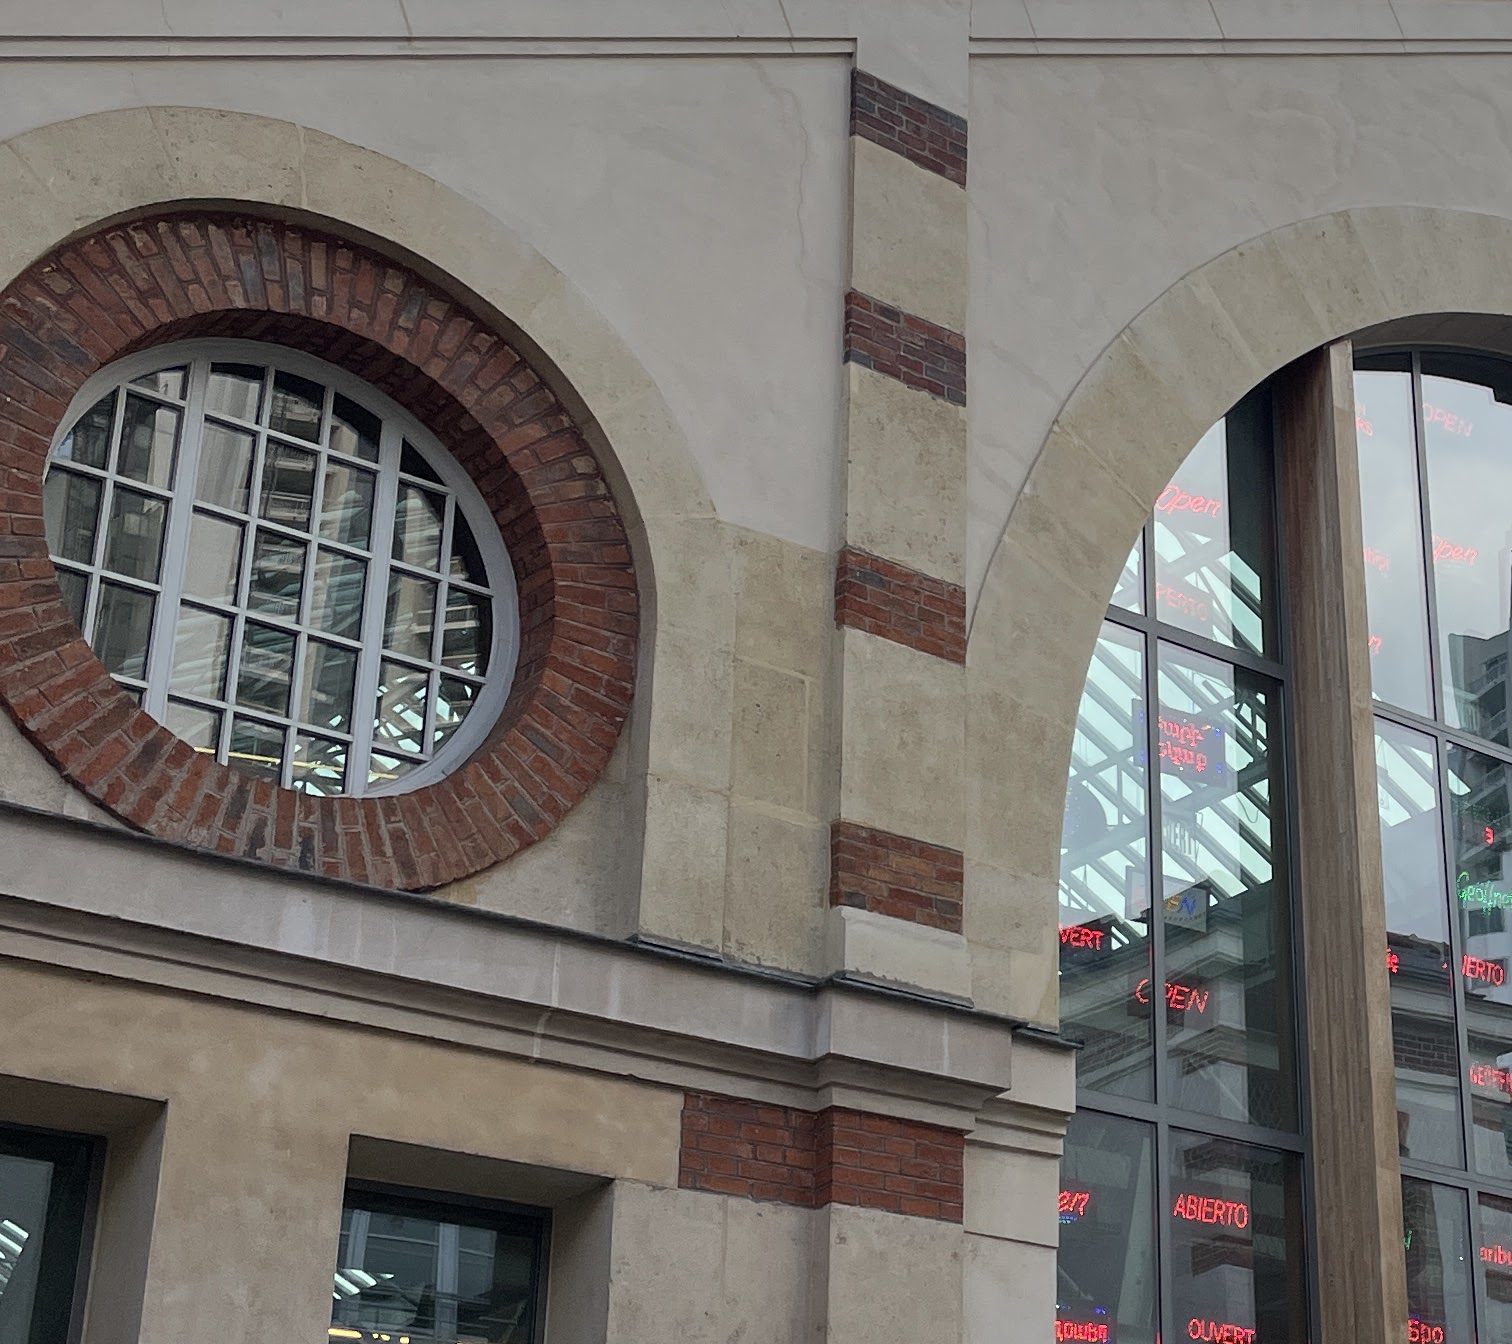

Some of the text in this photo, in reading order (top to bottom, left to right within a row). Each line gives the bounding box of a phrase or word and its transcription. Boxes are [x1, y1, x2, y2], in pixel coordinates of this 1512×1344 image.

[1155, 484, 1222, 518] Open
[1432, 535, 1479, 565] pen
[1059, 922, 1105, 951] VERT
[1174, 1193, 1250, 1229] ABIERTO
